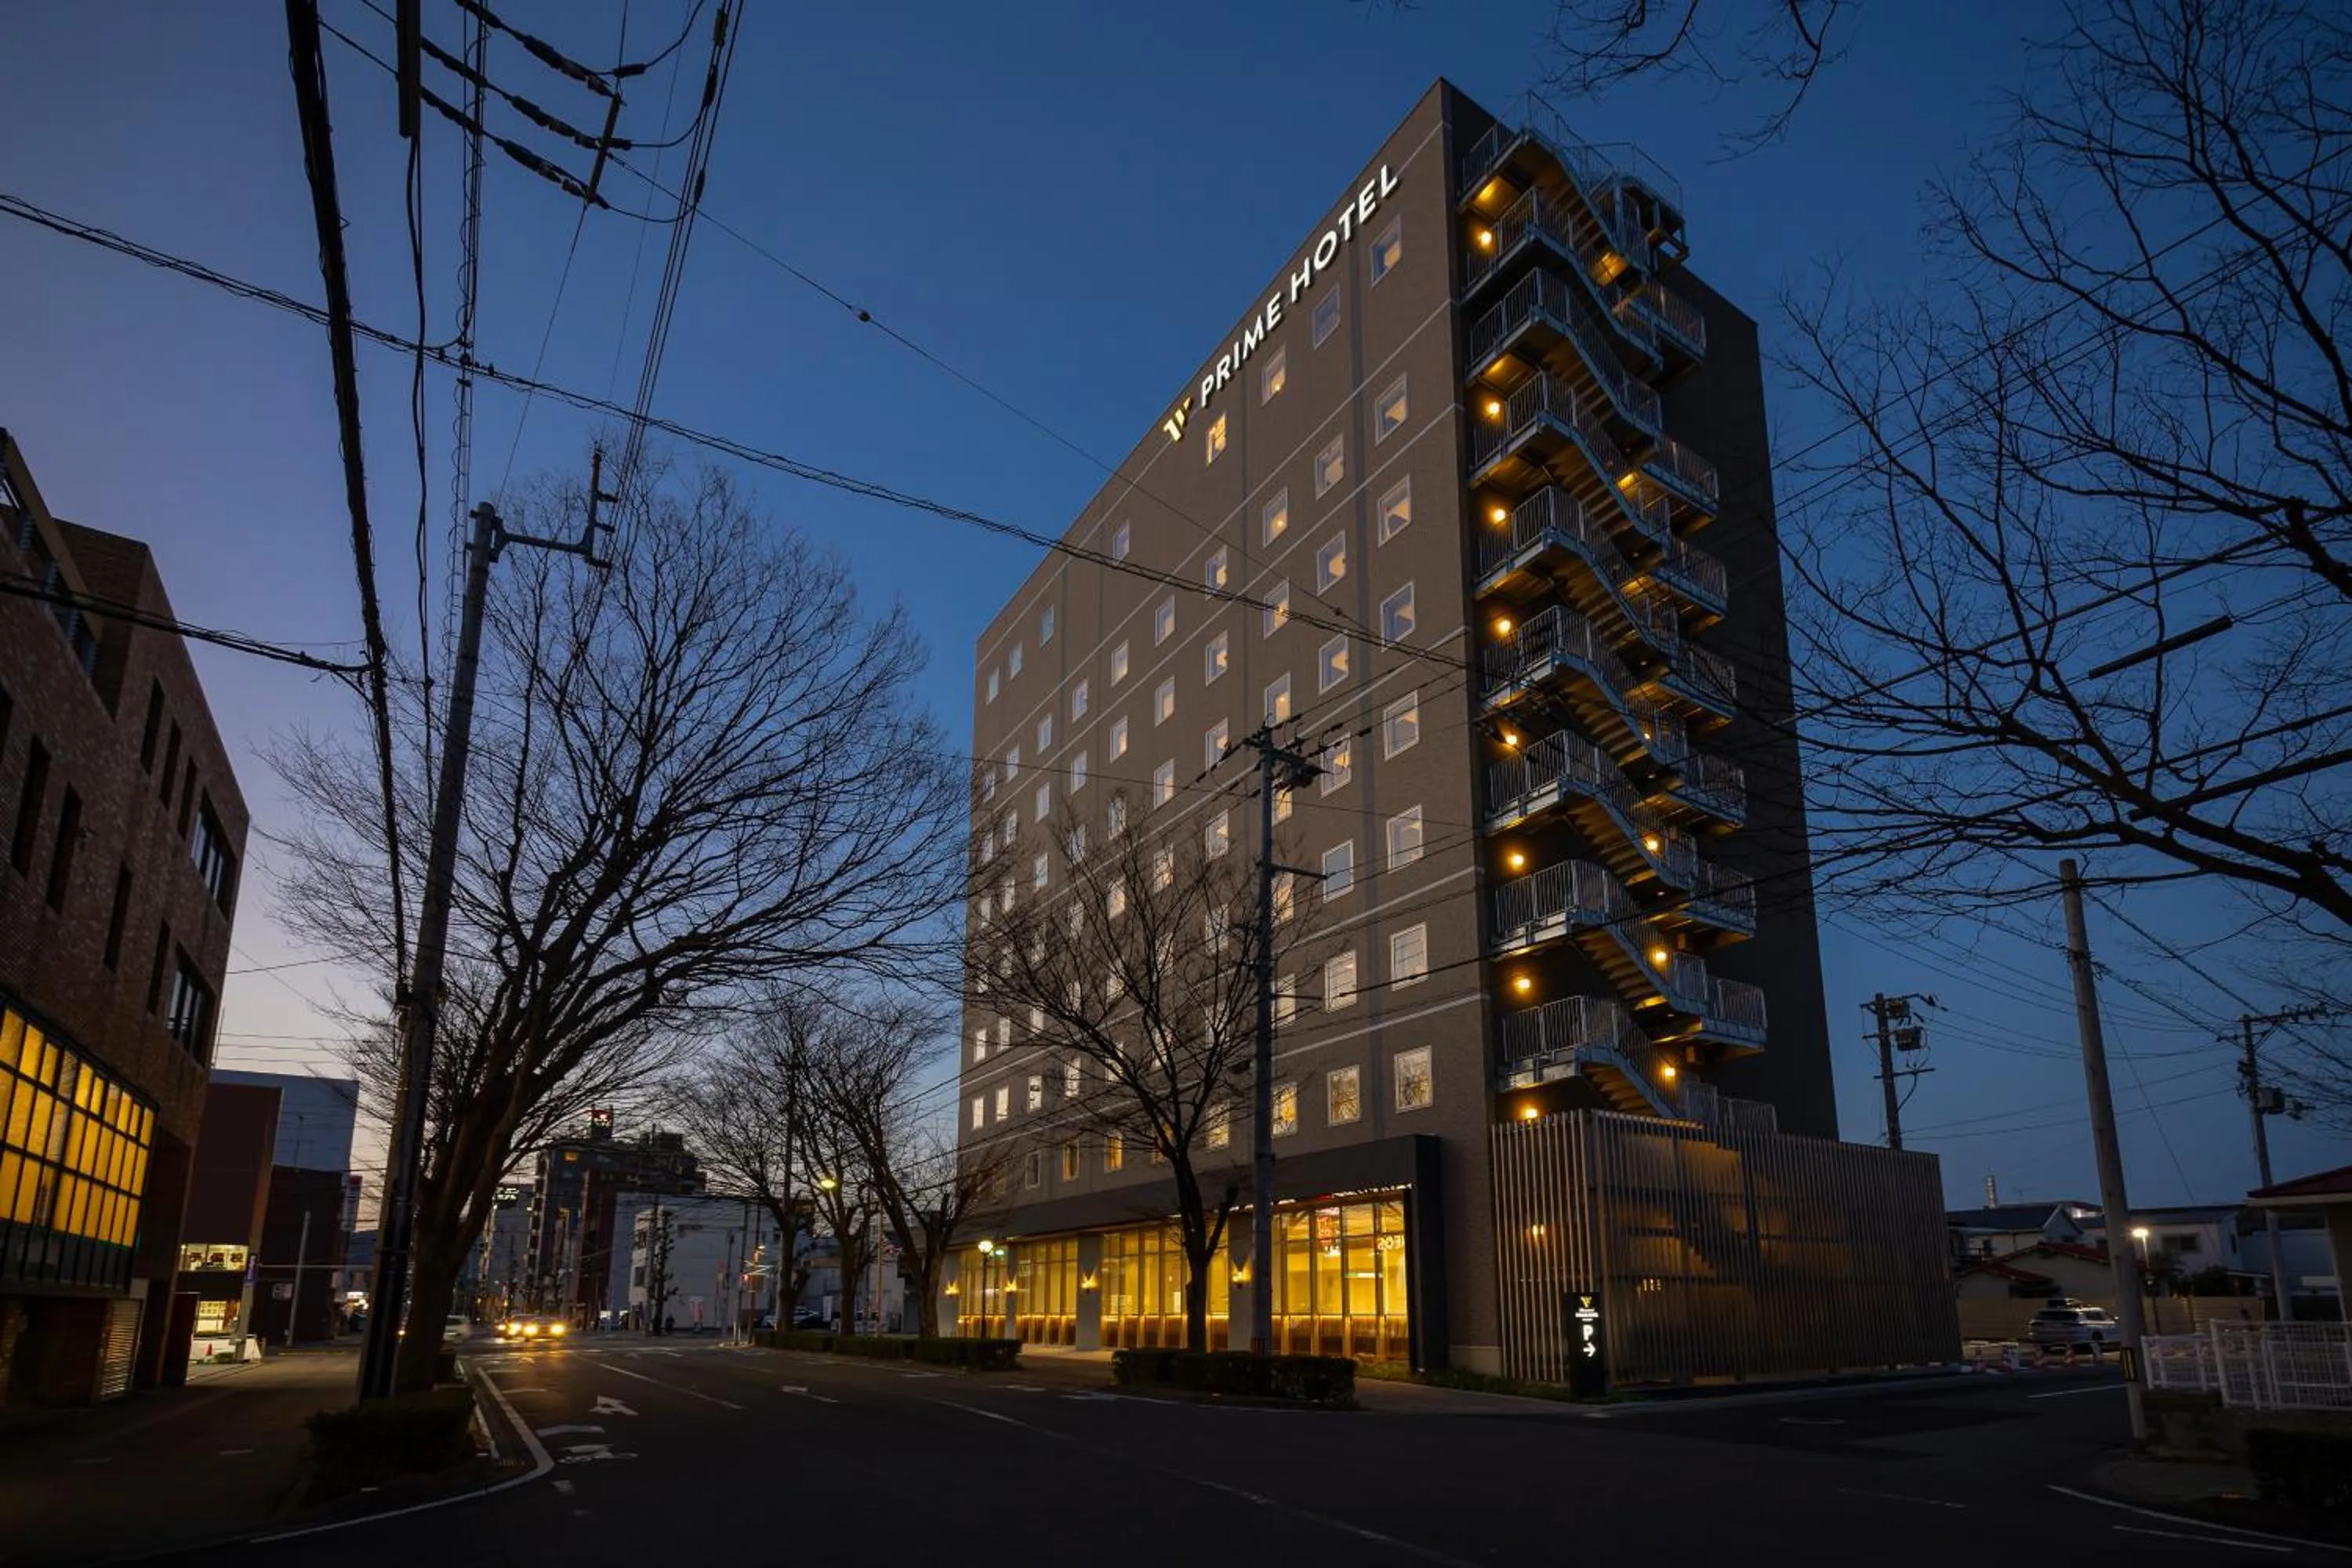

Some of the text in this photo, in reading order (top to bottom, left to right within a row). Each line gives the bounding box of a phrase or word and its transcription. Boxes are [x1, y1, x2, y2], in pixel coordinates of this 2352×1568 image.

[1200, 164, 1398, 408] PRIME HOTEL
[1583, 1324, 1594, 1341] P
